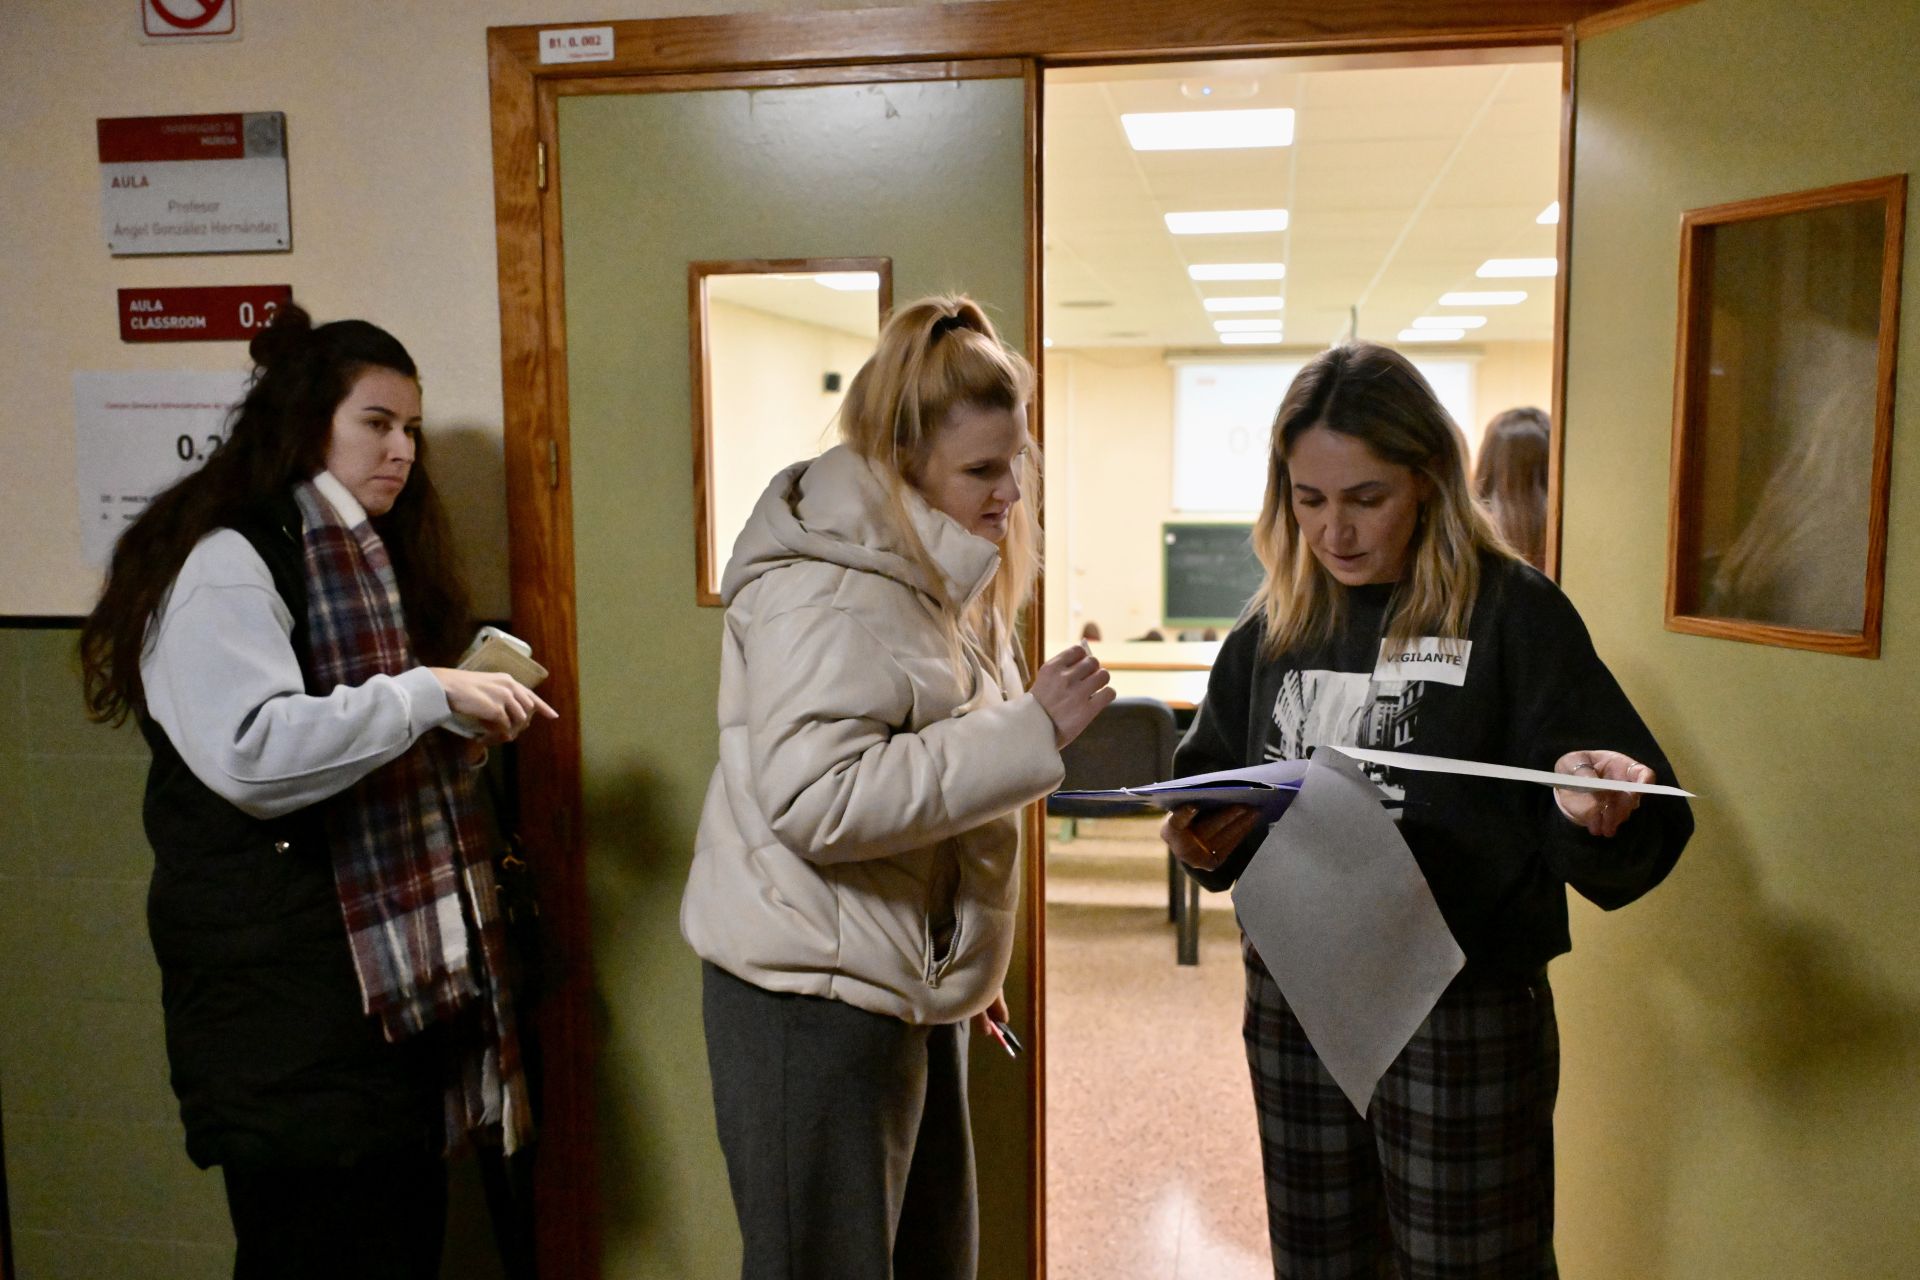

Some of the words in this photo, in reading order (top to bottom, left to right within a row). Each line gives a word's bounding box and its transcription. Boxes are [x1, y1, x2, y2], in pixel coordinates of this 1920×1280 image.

[111, 175, 150, 188] AULA
[167, 200, 221, 213] Profesor
[129, 299, 164, 312] AULA
[130, 315, 207, 330] CLASSROOM
